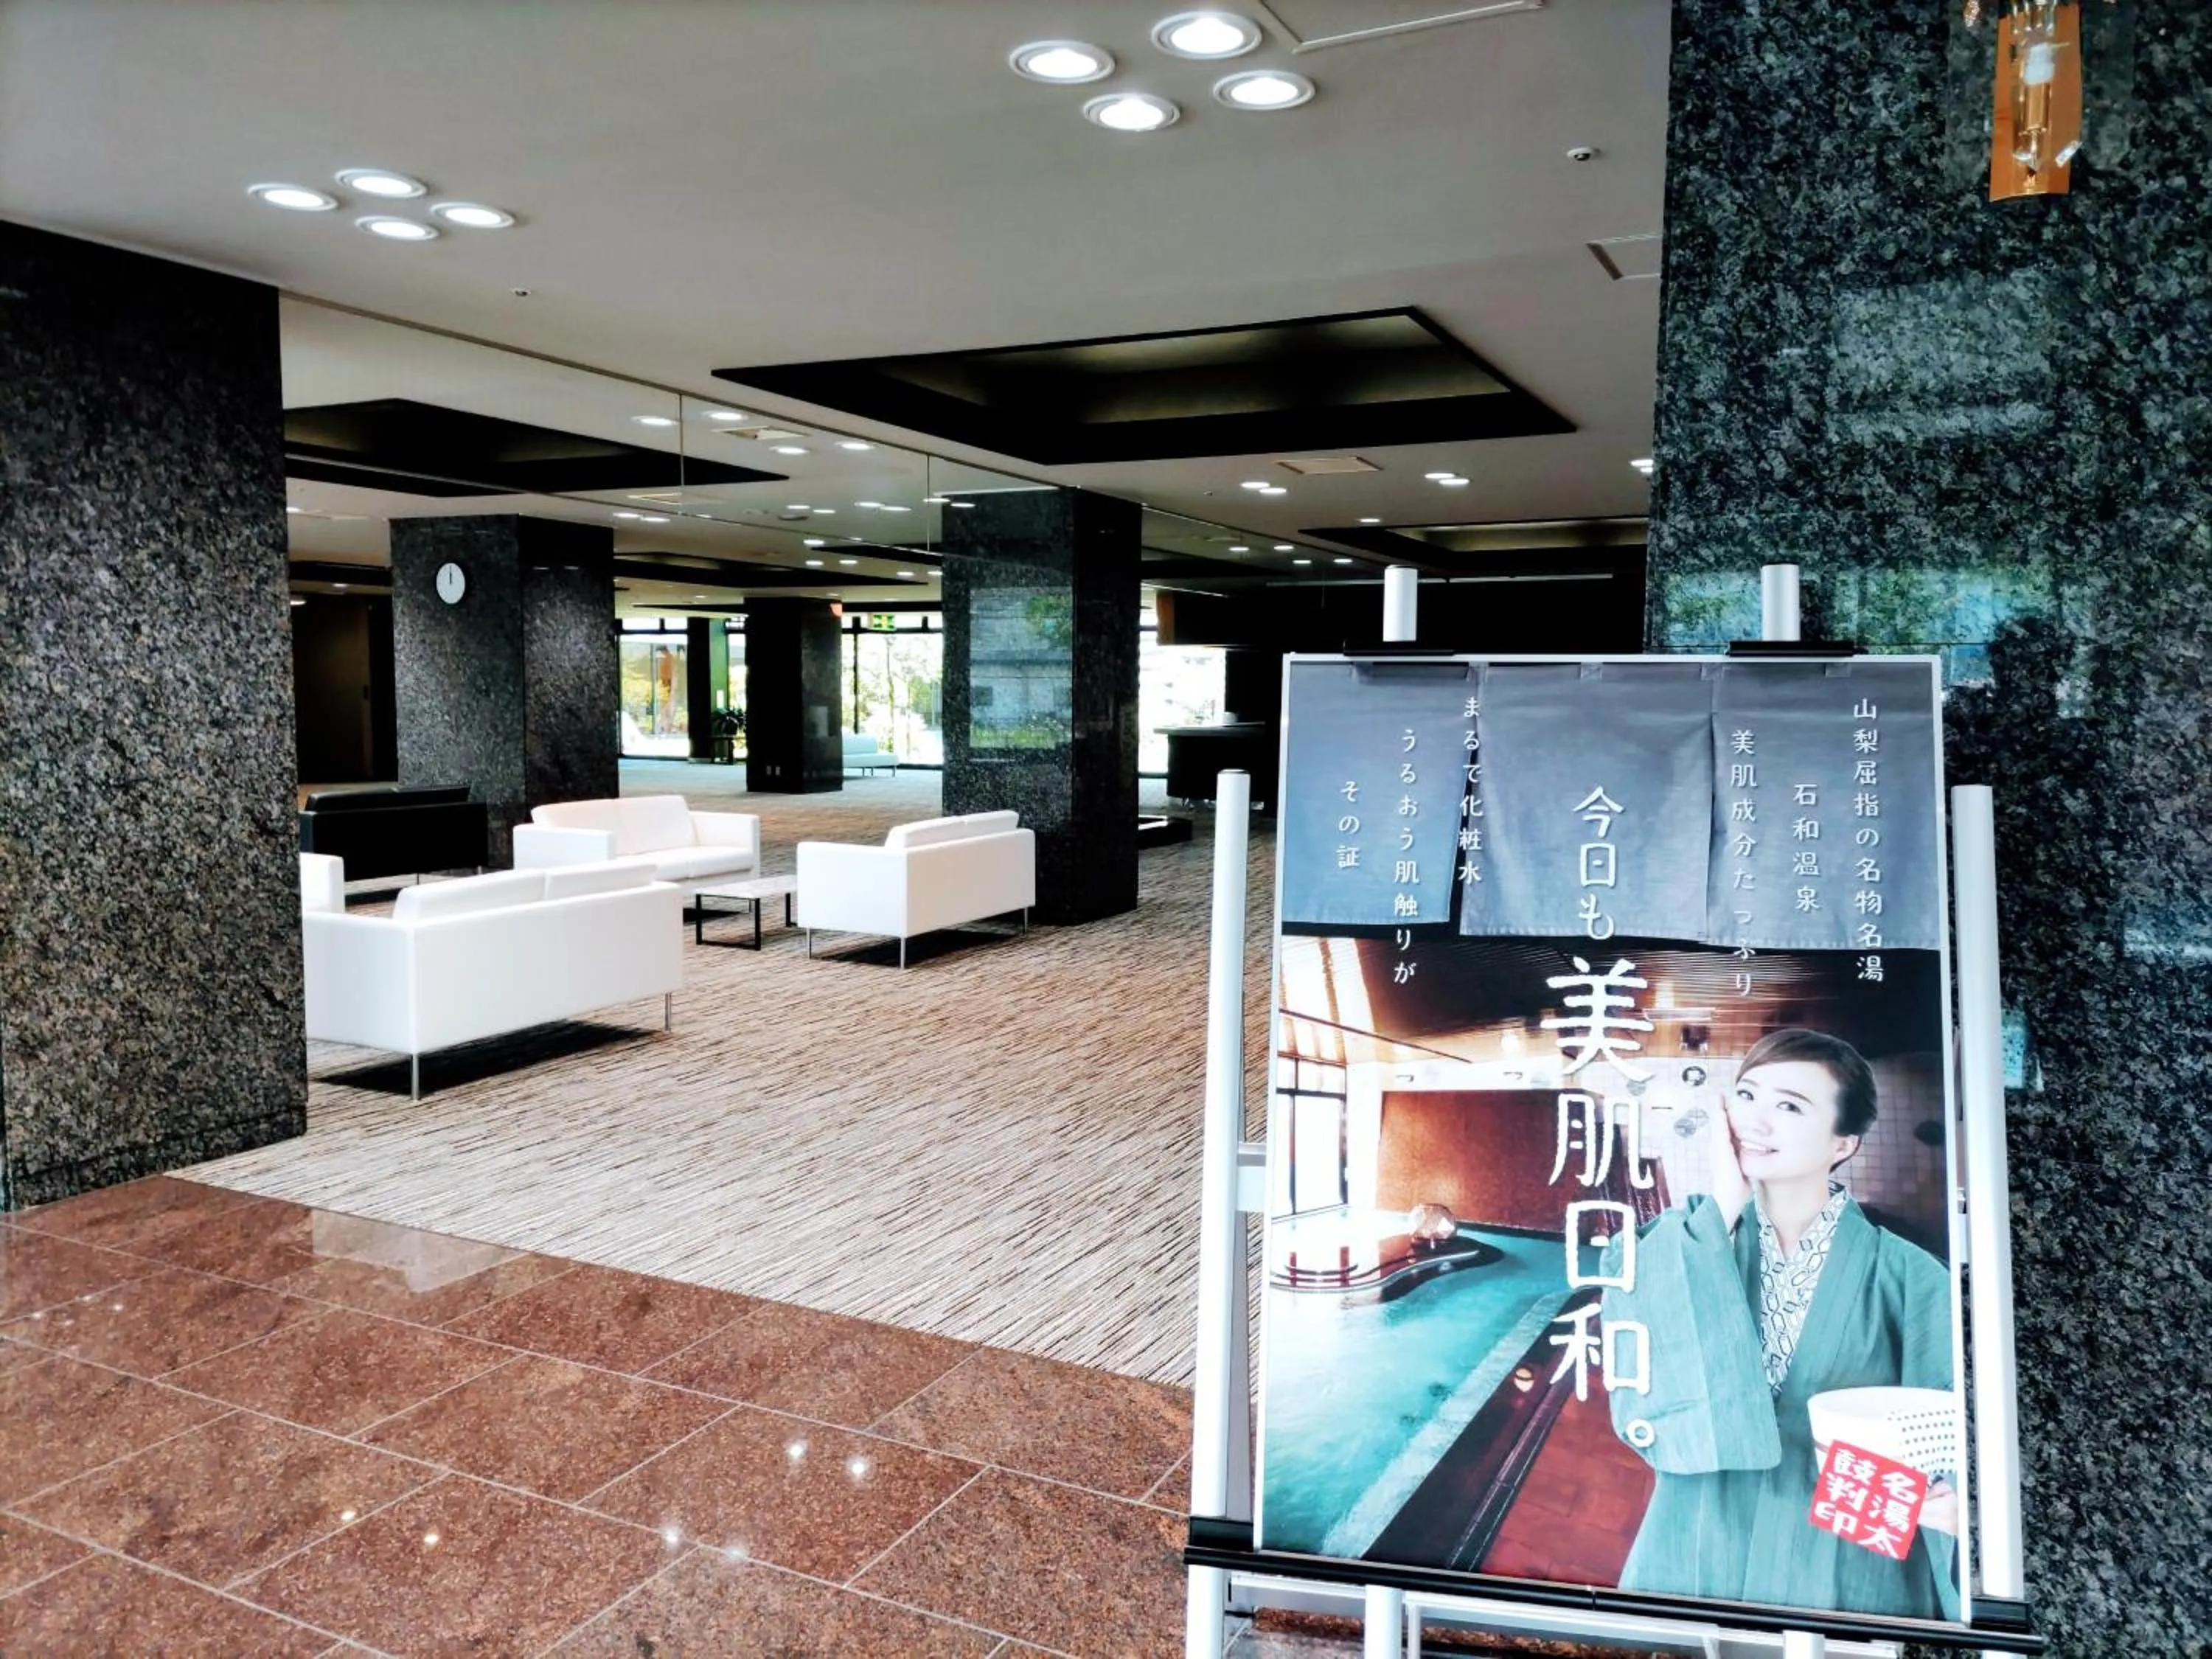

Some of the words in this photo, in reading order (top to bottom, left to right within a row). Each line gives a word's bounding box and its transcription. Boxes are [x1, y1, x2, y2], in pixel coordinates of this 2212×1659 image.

[1336, 780, 1360, 869] その証
[1394, 729, 1419, 984] うるおう肌触りが
[1458, 697, 1482, 883] まるで化粧水
[1792, 783, 1820, 912] 石和温泉
[1853, 698, 1883, 982] 山梨屈指の名物名湯
